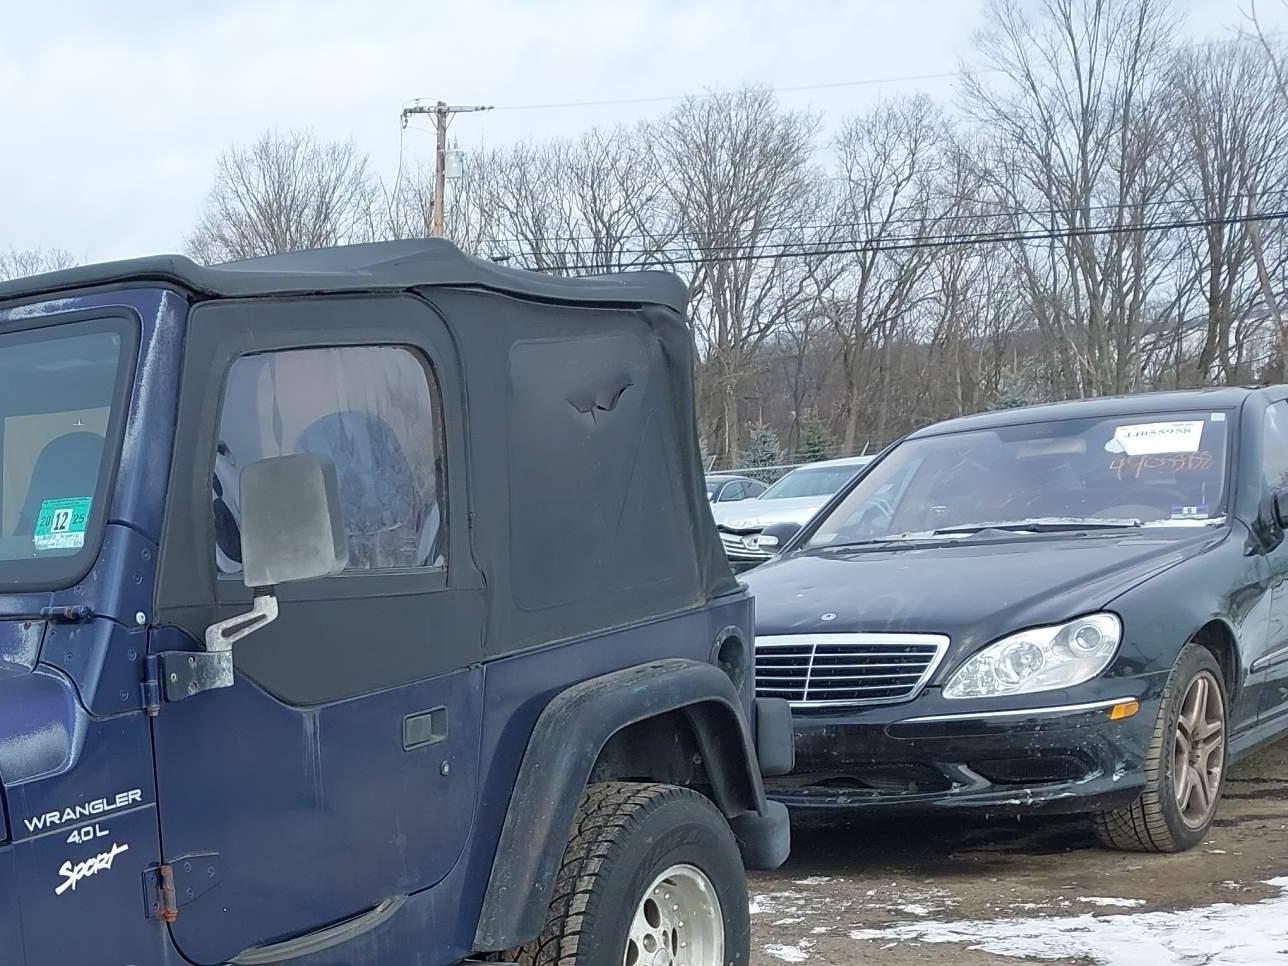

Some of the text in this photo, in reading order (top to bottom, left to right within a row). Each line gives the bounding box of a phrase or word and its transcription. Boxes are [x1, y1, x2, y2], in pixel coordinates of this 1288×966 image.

[40, 511, 85, 531] 20 12 25
[24, 789, 142, 832] WRANGLER
